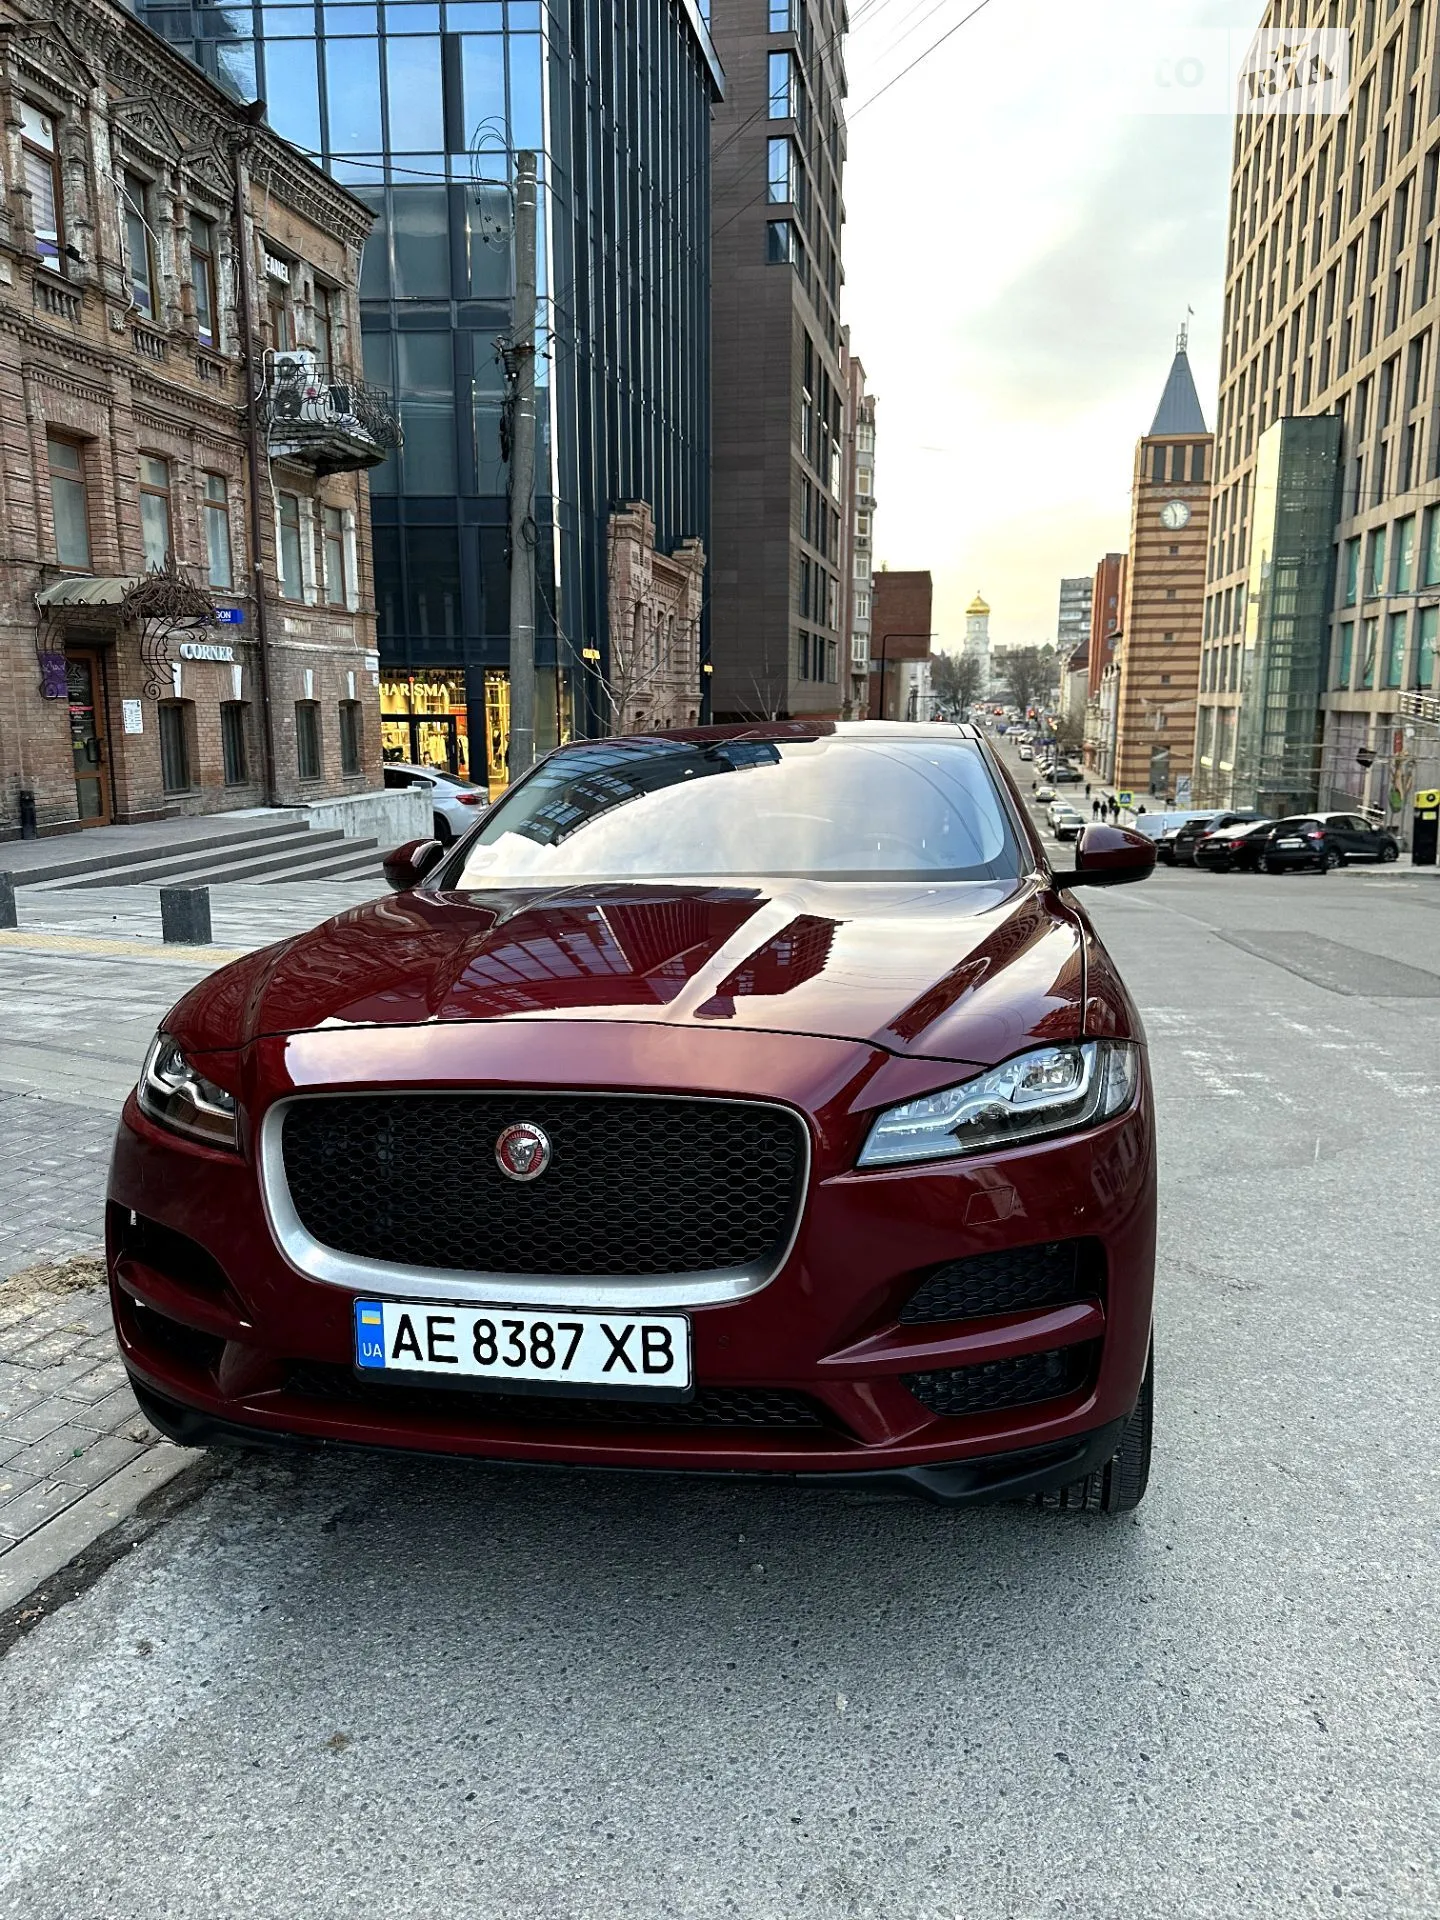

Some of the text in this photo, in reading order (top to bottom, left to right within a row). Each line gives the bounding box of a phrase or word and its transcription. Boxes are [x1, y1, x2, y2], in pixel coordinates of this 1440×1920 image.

[180, 643, 235, 662] CORNER
[363, 1342, 383, 1359] UA
[391, 1313, 675, 1374] AE 8387 XB
